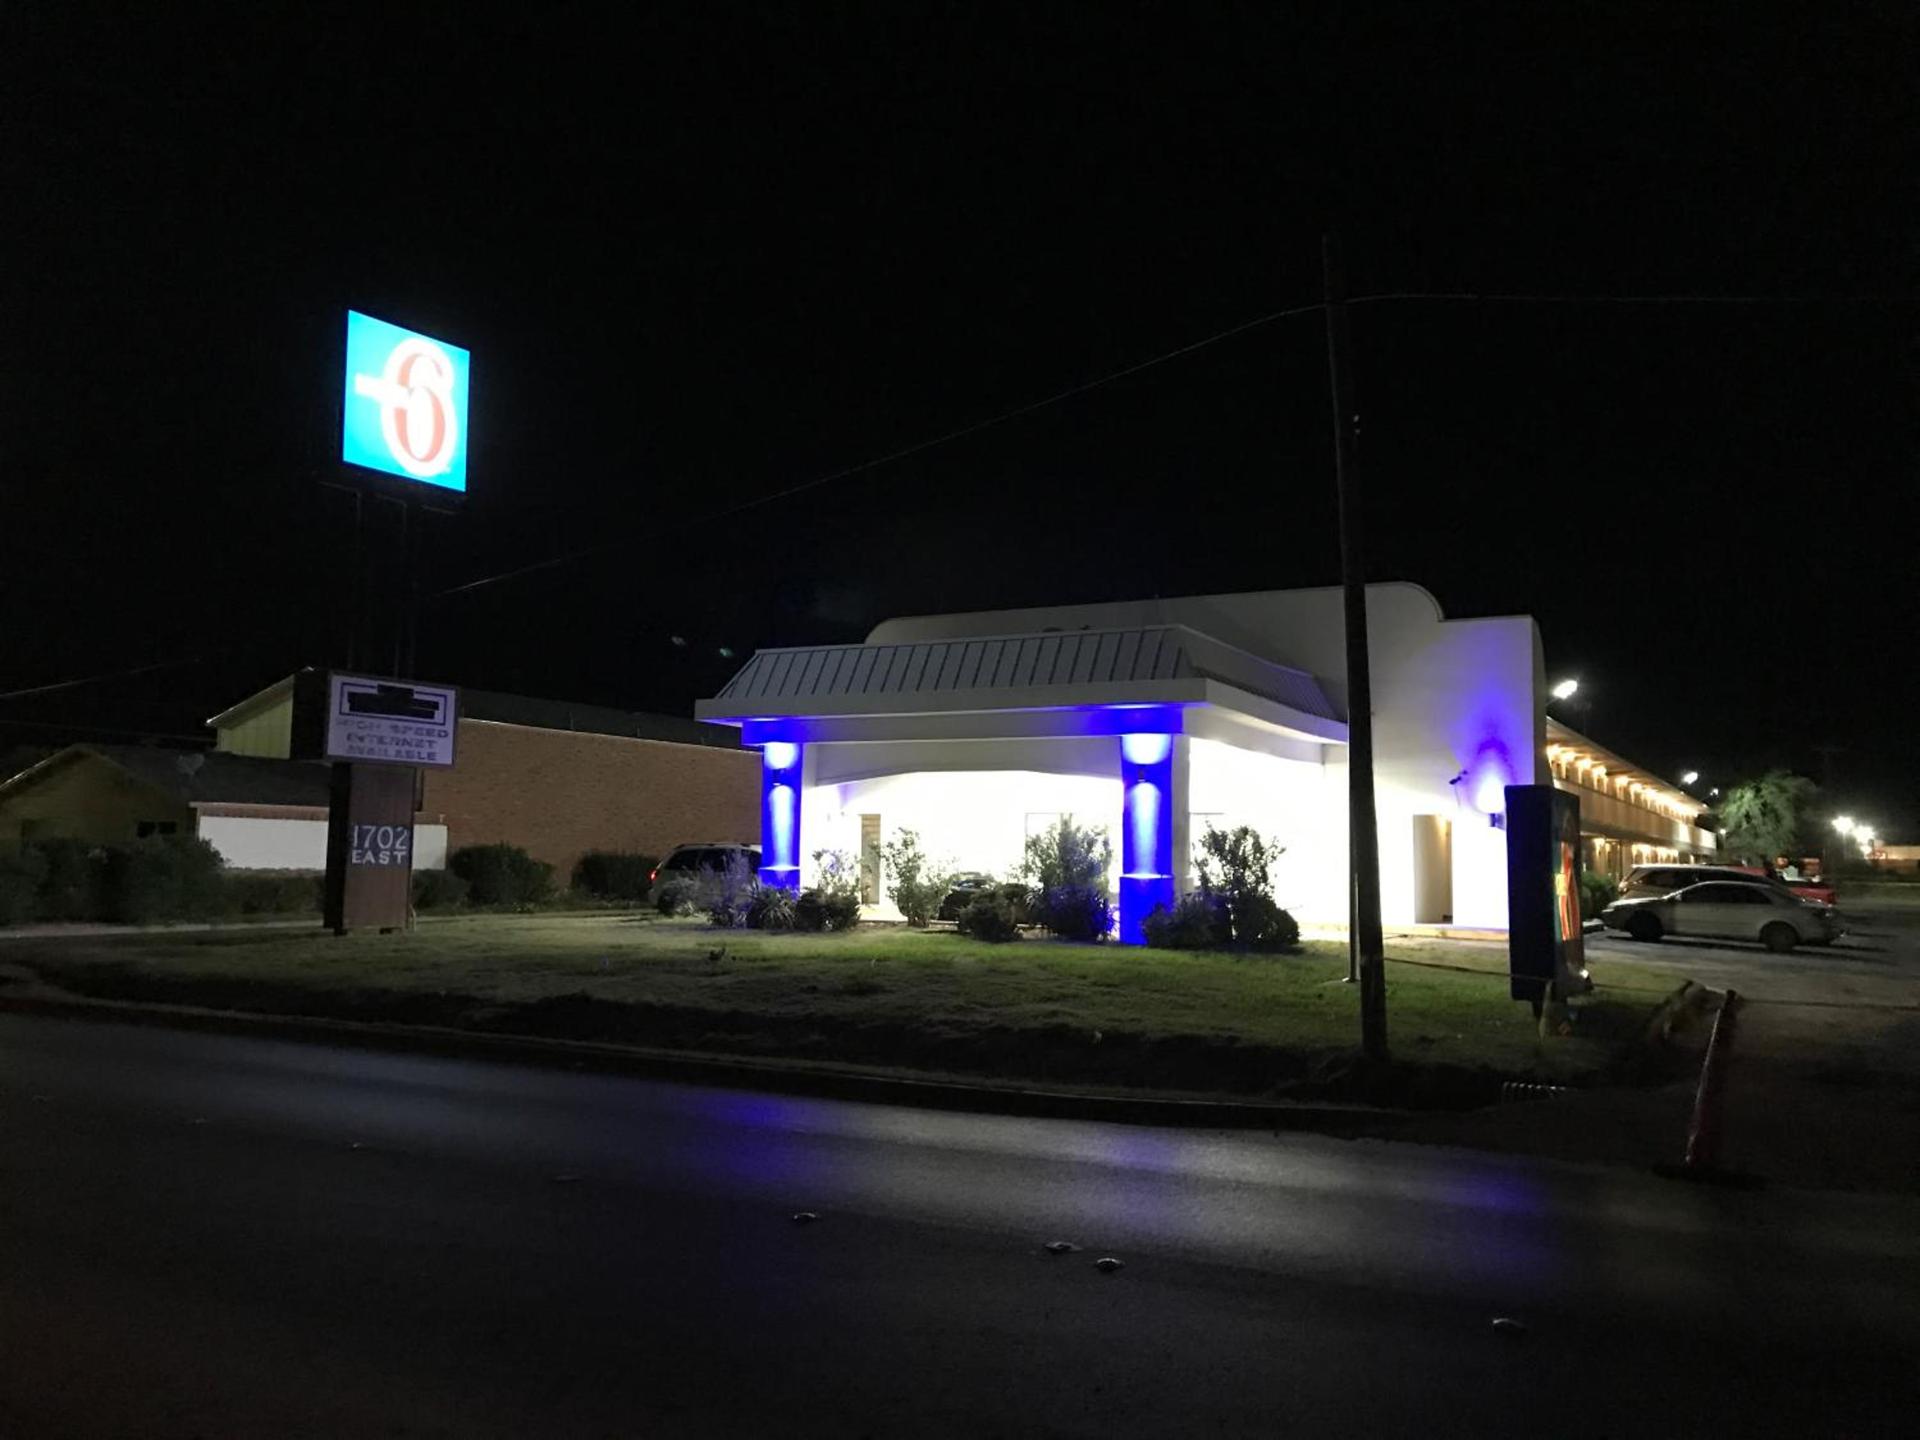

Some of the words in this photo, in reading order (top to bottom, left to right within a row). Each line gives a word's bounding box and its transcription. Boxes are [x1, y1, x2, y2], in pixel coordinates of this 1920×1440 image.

[379, 337, 458, 477] 6
[353, 825, 408, 849] 1702
[351, 849, 407, 864] EAST
